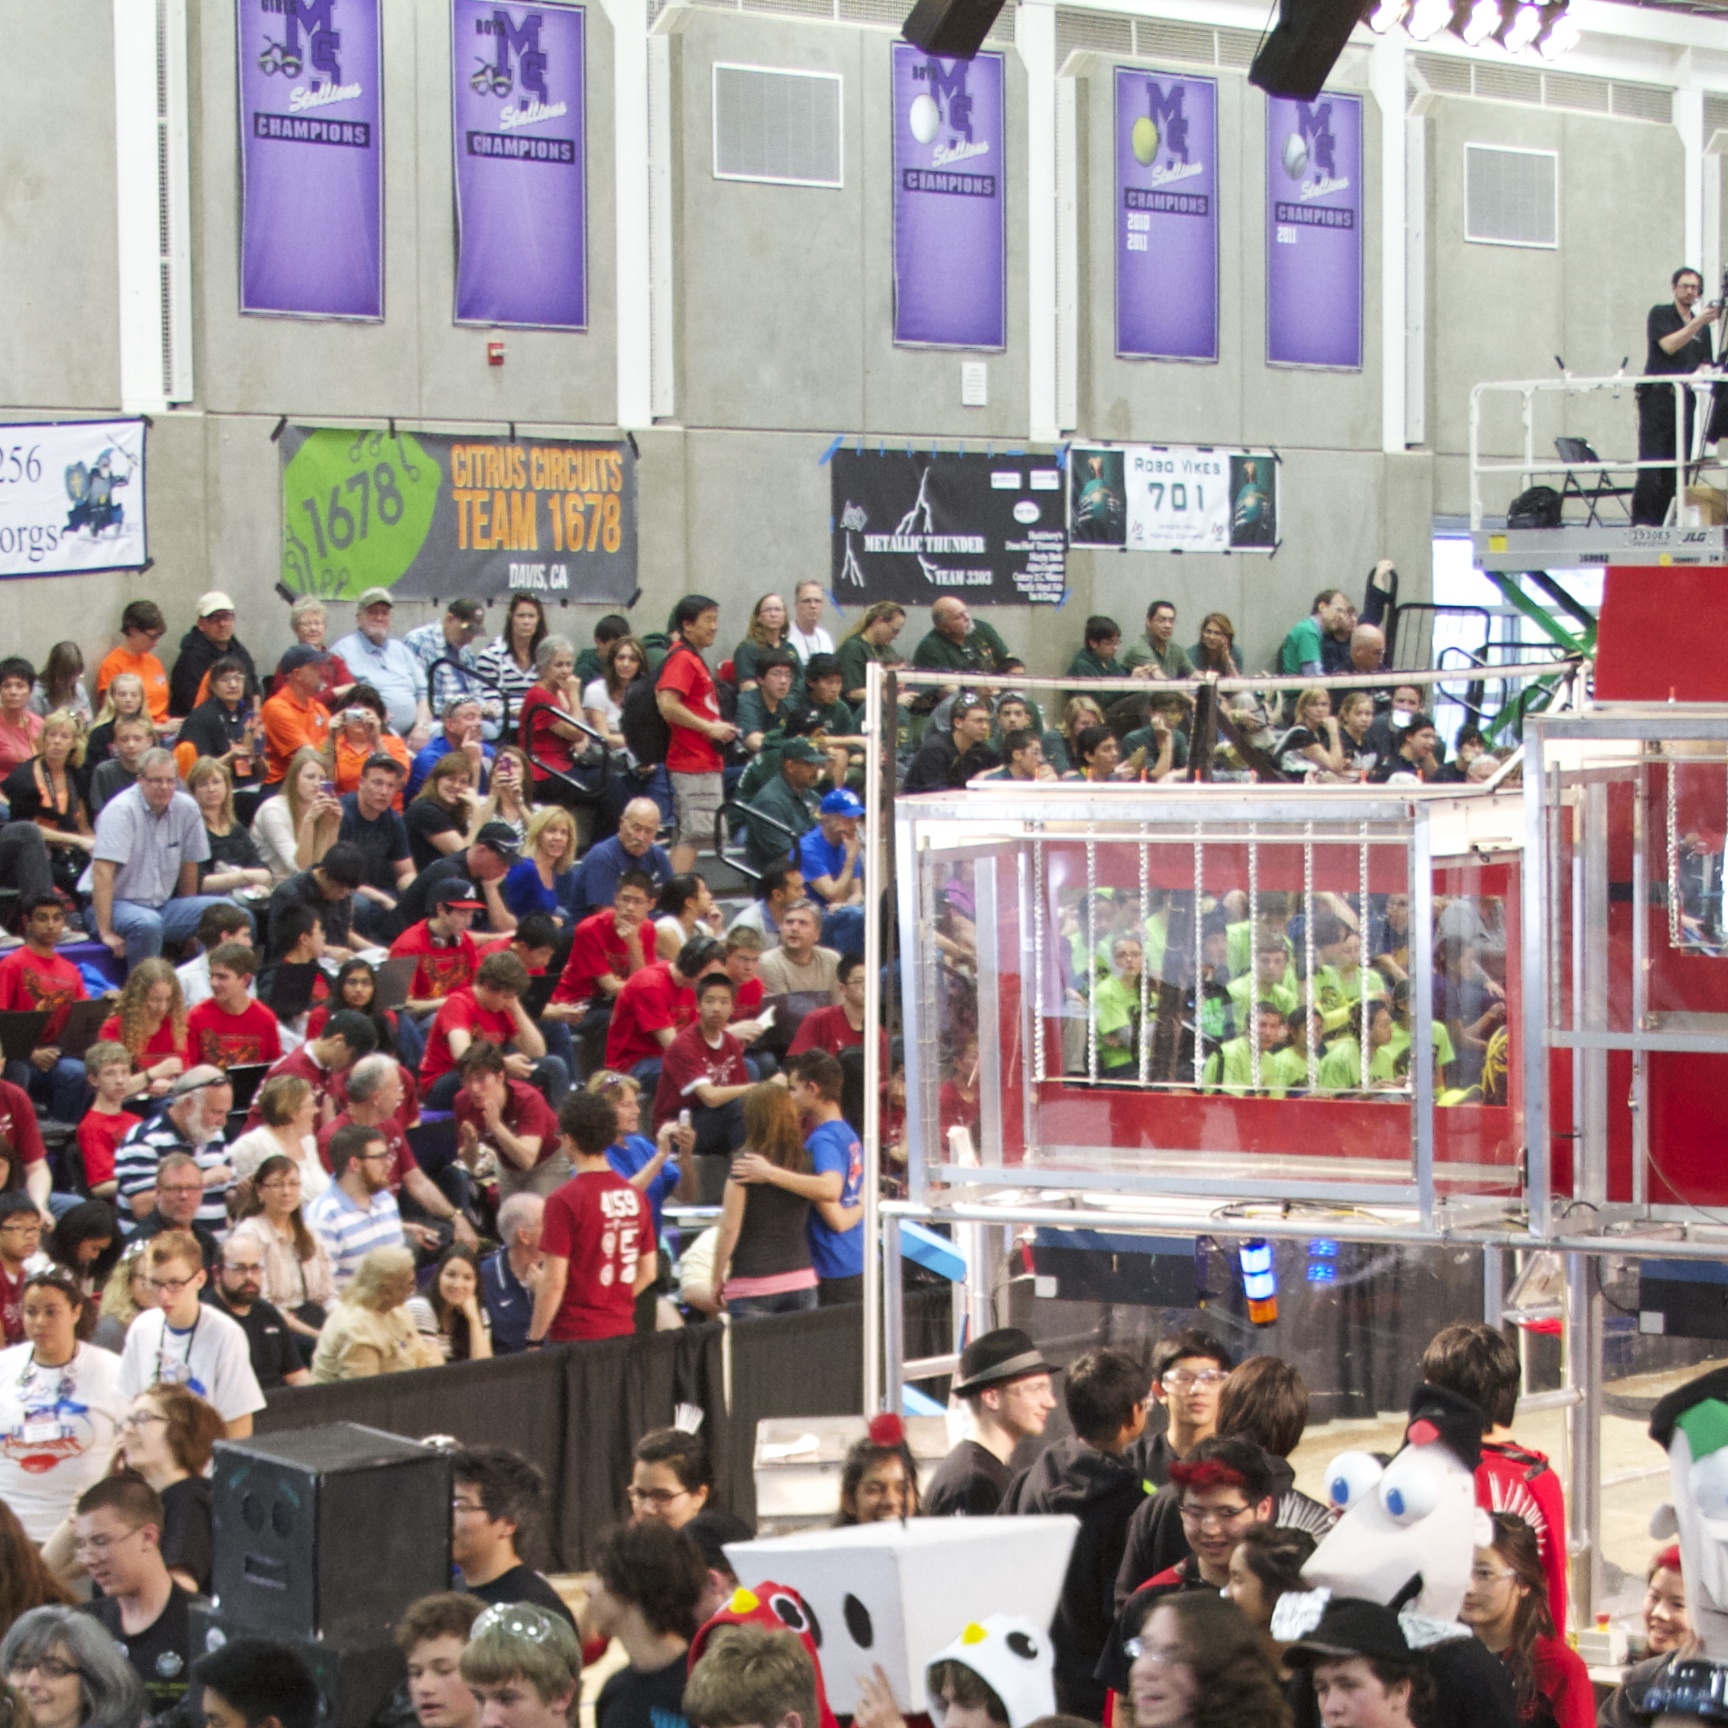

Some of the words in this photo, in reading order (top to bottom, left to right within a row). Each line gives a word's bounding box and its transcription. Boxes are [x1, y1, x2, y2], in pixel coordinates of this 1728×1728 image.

[289, 82, 362, 113] Stallions
[500, 101, 567, 131] Stallions
[257, 115, 367, 145] CHAMPIONS
[473, 135, 571, 161] CHAMPIONS
[906, 172, 993, 195] CHAMPIONS
[1127, 190, 1207, 214] CHAMPIONS
[1126, 212, 1151, 232] 2010
[1278, 204, 1352, 228] CHAMPIONS
[1126, 233, 1148, 252] 2011
[1276, 226, 1298, 244] 2011
[451, 444, 527, 489] CITRUS
[530, 447, 622, 493] CIRCUITS
[1182, 459, 1221, 476] VIKES
[1148, 482, 1203, 513] 701
[303, 462, 404, 560] 1678
[452, 489, 539, 551] TEAM
[548, 493, 621, 553] 1678
[864, 534, 923, 552] METALLIC
[926, 535, 986, 553] THUNDER
[1683, 532, 1707, 543] JLG
[509, 563, 548, 592] DAVIS,
[550, 564, 569, 589] CA
[935, 569, 965, 585] TEAM
[965, 570, 993, 585] 3303
[599, 1189, 640, 1218] 4159
